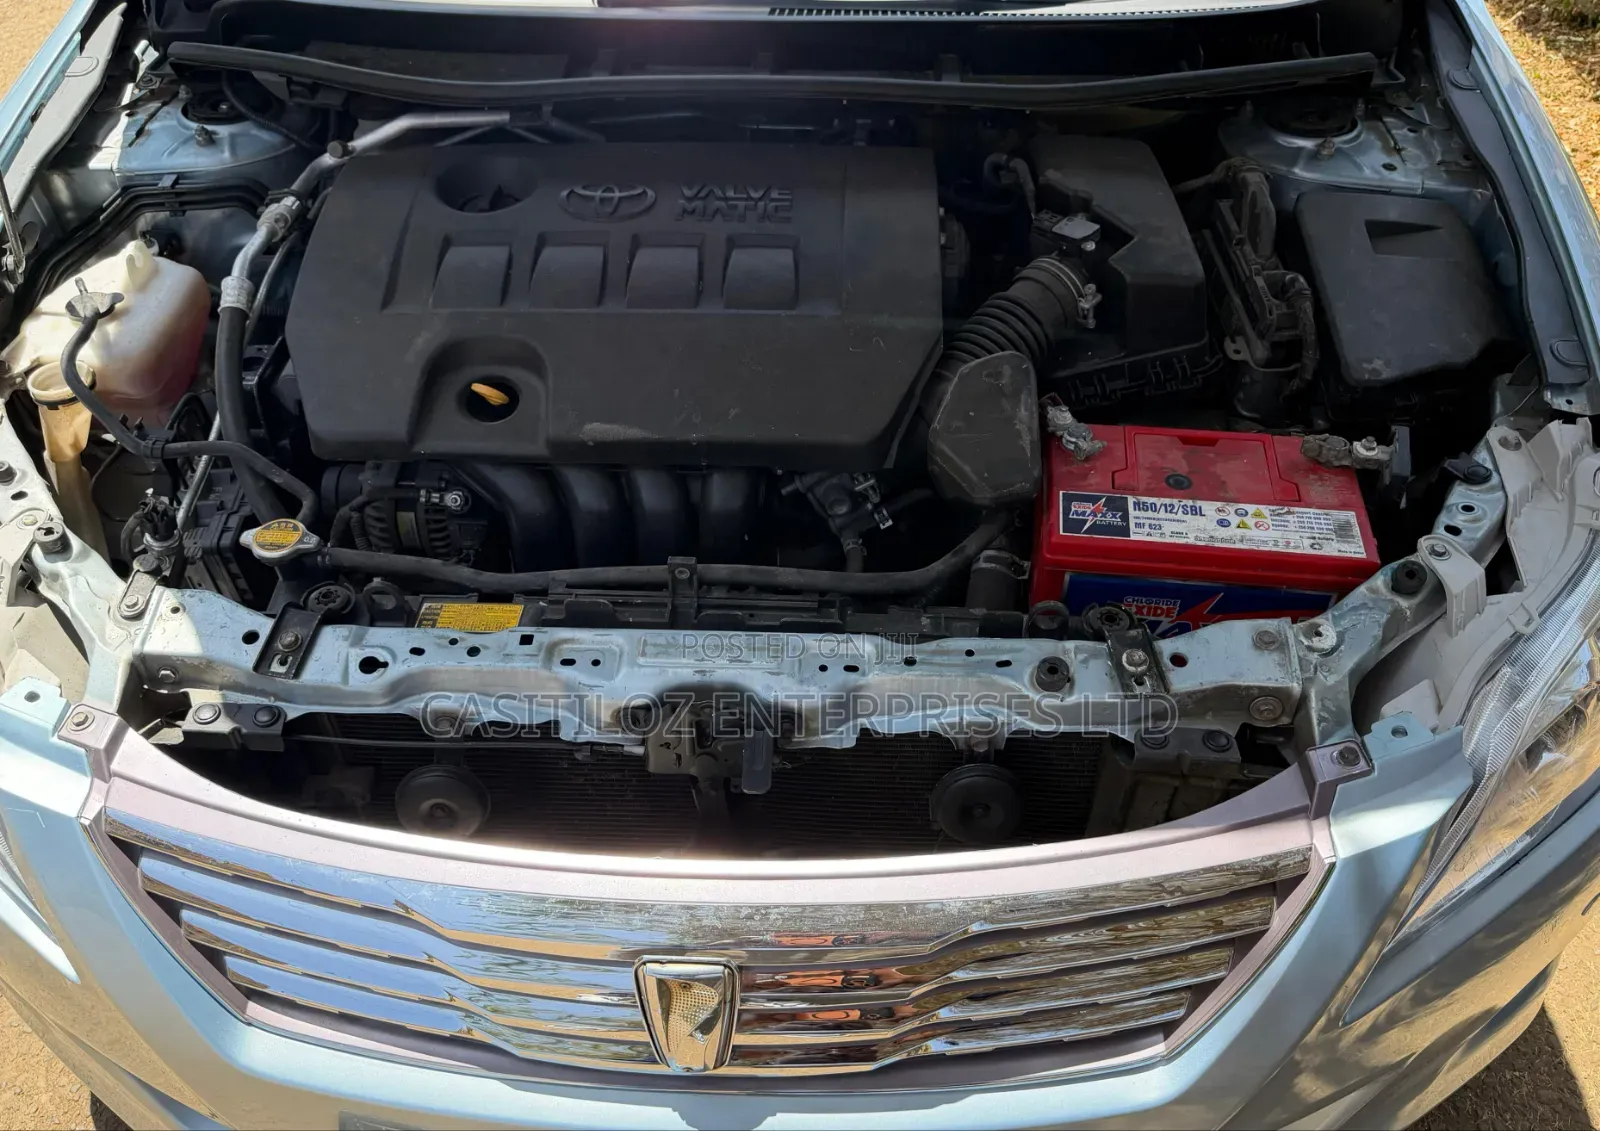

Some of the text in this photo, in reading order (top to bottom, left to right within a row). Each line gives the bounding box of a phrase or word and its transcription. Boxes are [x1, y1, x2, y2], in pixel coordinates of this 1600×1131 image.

[680, 184, 792, 200] VALVE
[675, 200, 794, 223] MATIC
[1069, 508, 1123, 521] MAXX
[1132, 500, 1206, 517] N50/12/SBL
[1134, 521, 1146, 530] MF
[1123, 596, 1181, 607] CHLORIDE
